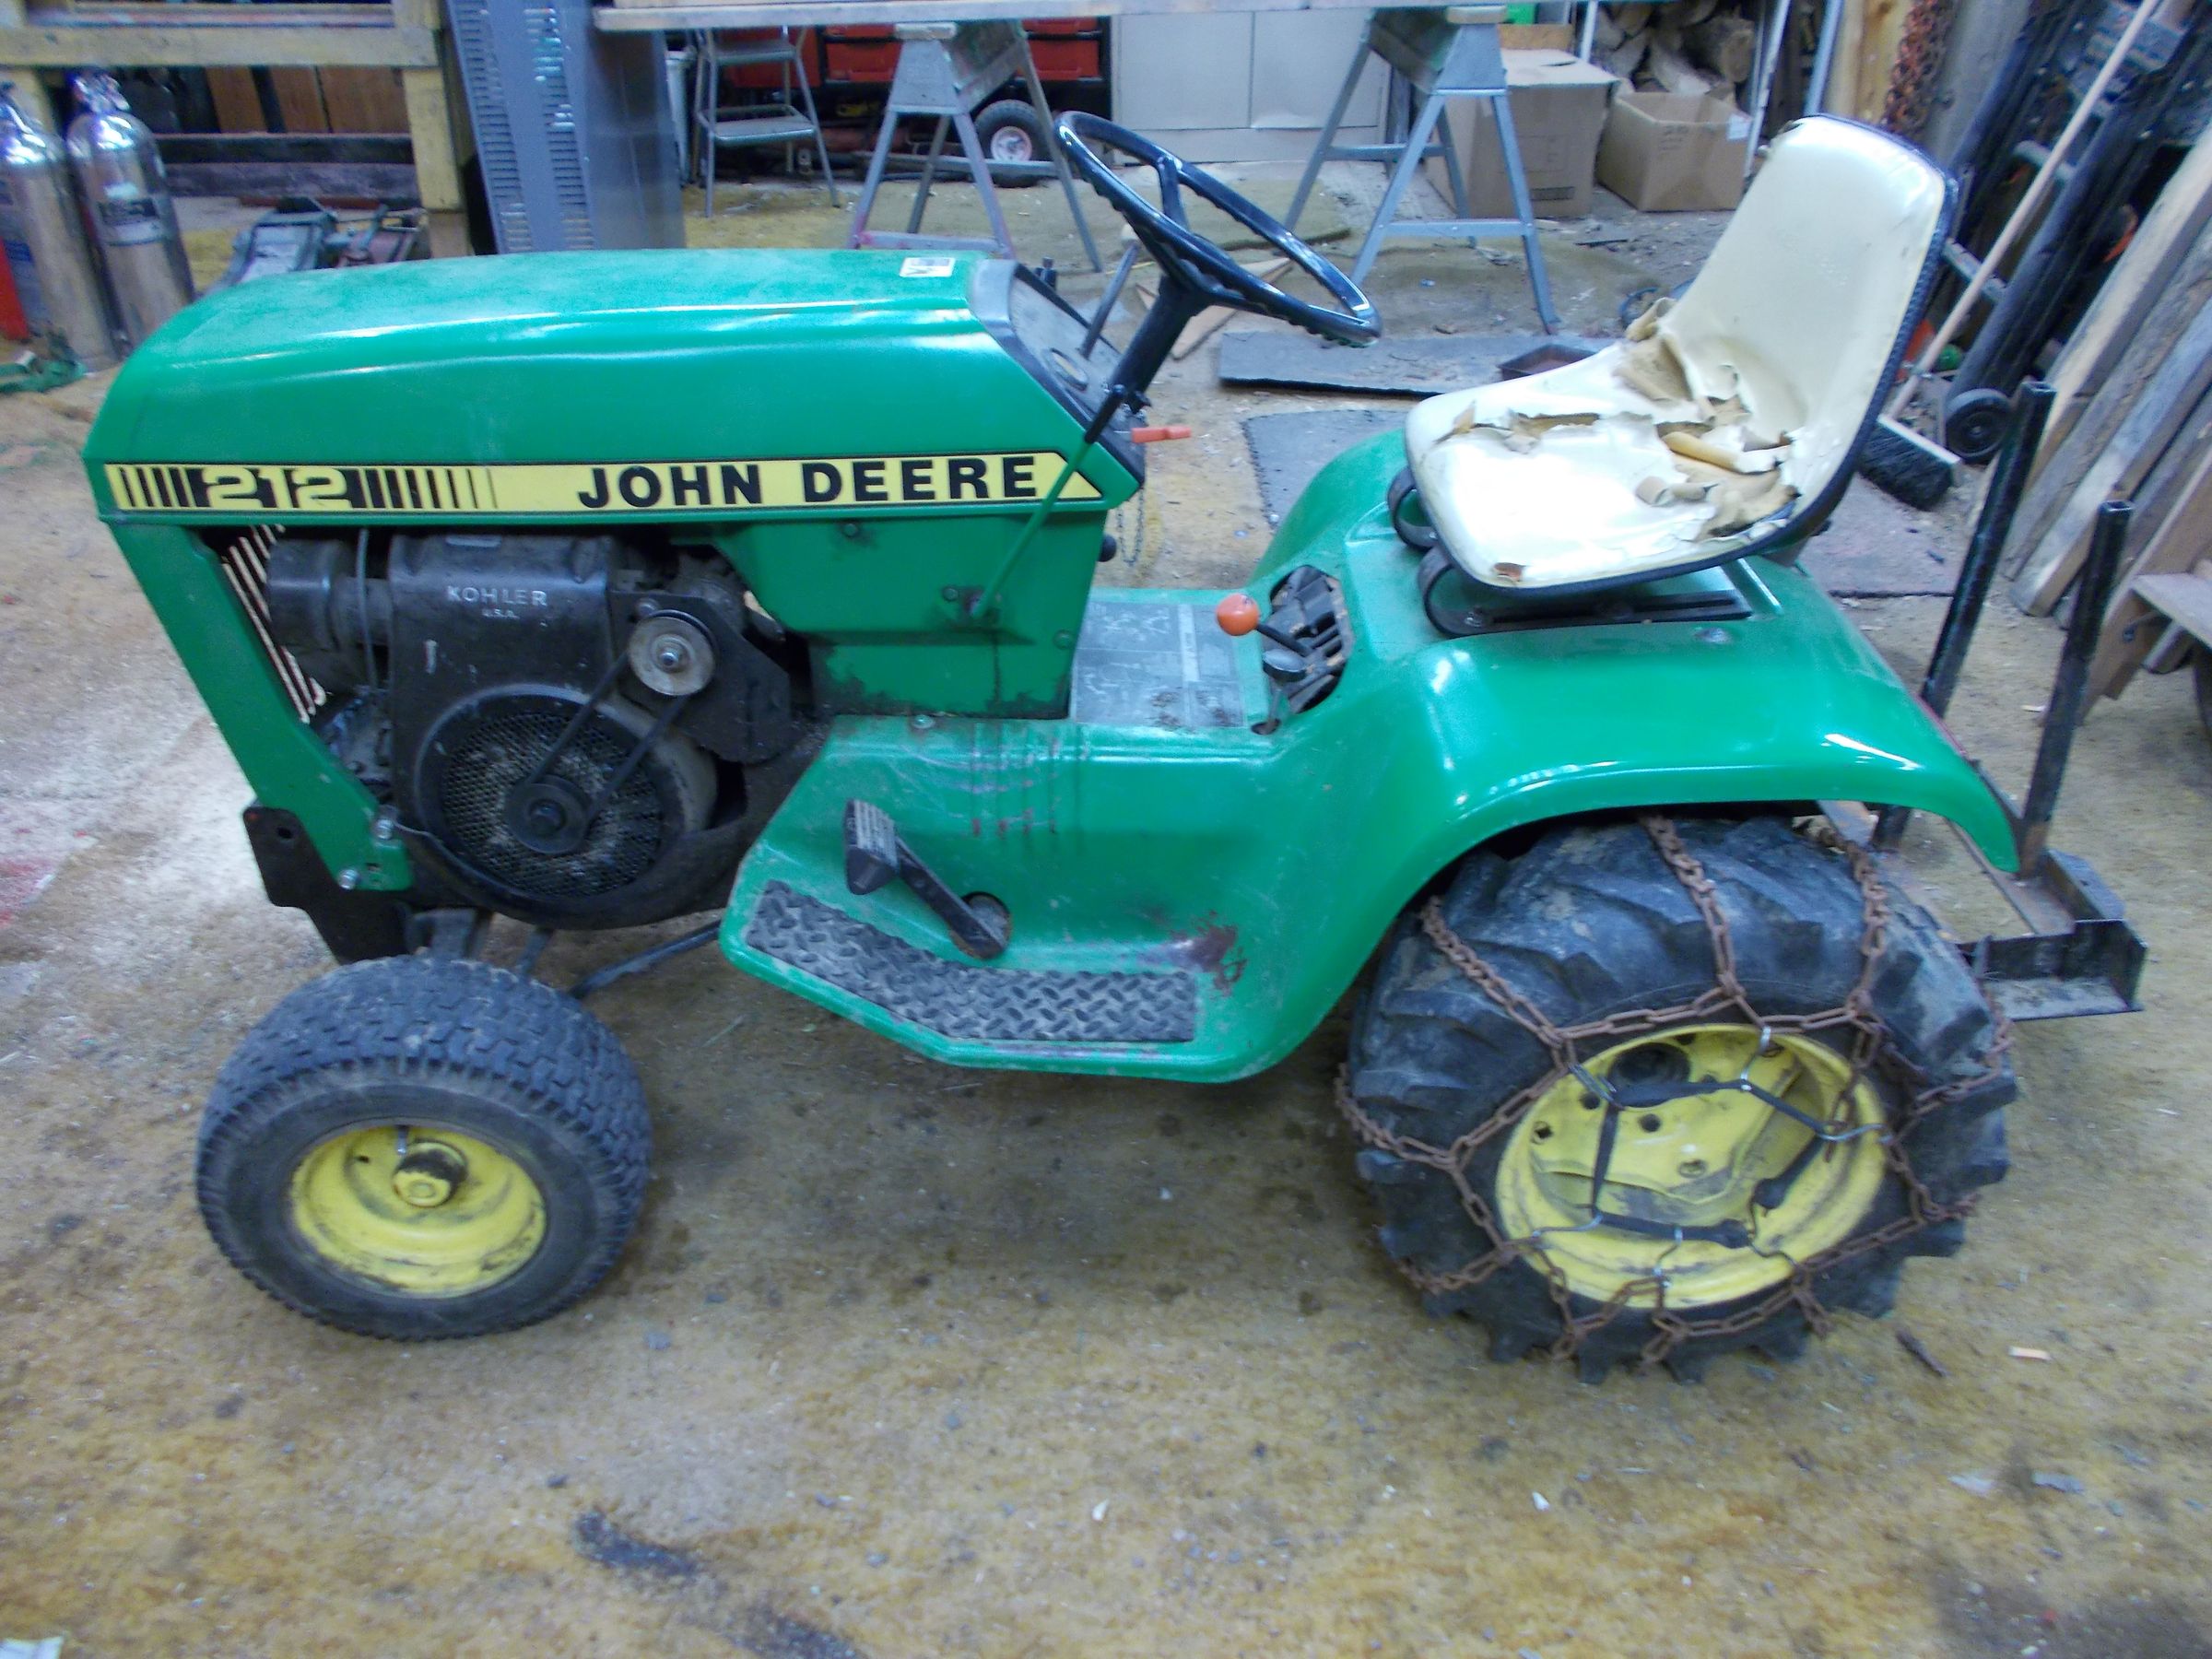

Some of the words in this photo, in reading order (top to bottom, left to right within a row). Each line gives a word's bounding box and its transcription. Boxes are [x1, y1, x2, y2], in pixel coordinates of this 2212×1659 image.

[202, 466, 353, 509] 212
[578, 465, 763, 509] JOHN
[802, 457, 1037, 502] DEERE
[446, 586, 548, 606] KOHLER
